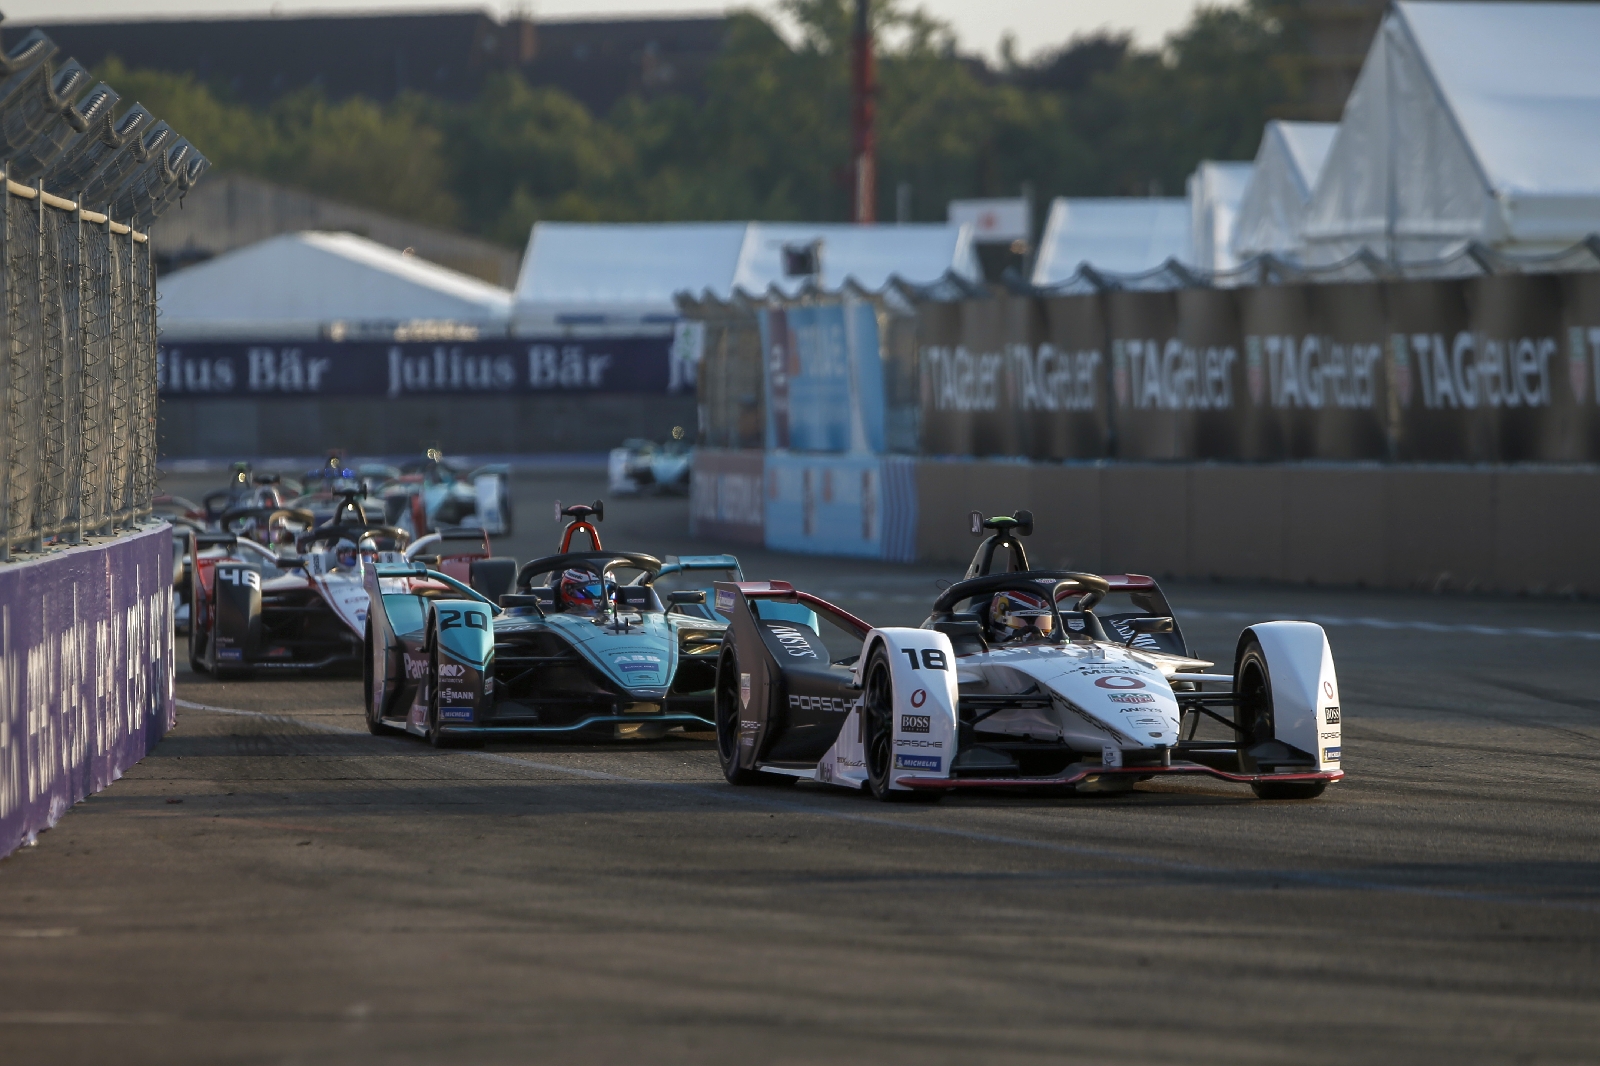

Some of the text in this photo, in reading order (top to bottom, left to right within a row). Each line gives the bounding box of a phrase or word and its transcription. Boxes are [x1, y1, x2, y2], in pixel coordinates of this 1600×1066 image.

[248, 347, 330, 391] Bär
[386, 345, 612, 397] Julius Bär
[219, 568, 260, 592] 48
[441, 609, 487, 632] 20
[901, 648, 949, 671] 18
[902, 716, 929, 728] BOSS
[1326, 708, 1340, 720] BOSS
[893, 739, 942, 748] PORSCHE
[904, 759, 938, 767] MICHELIN
